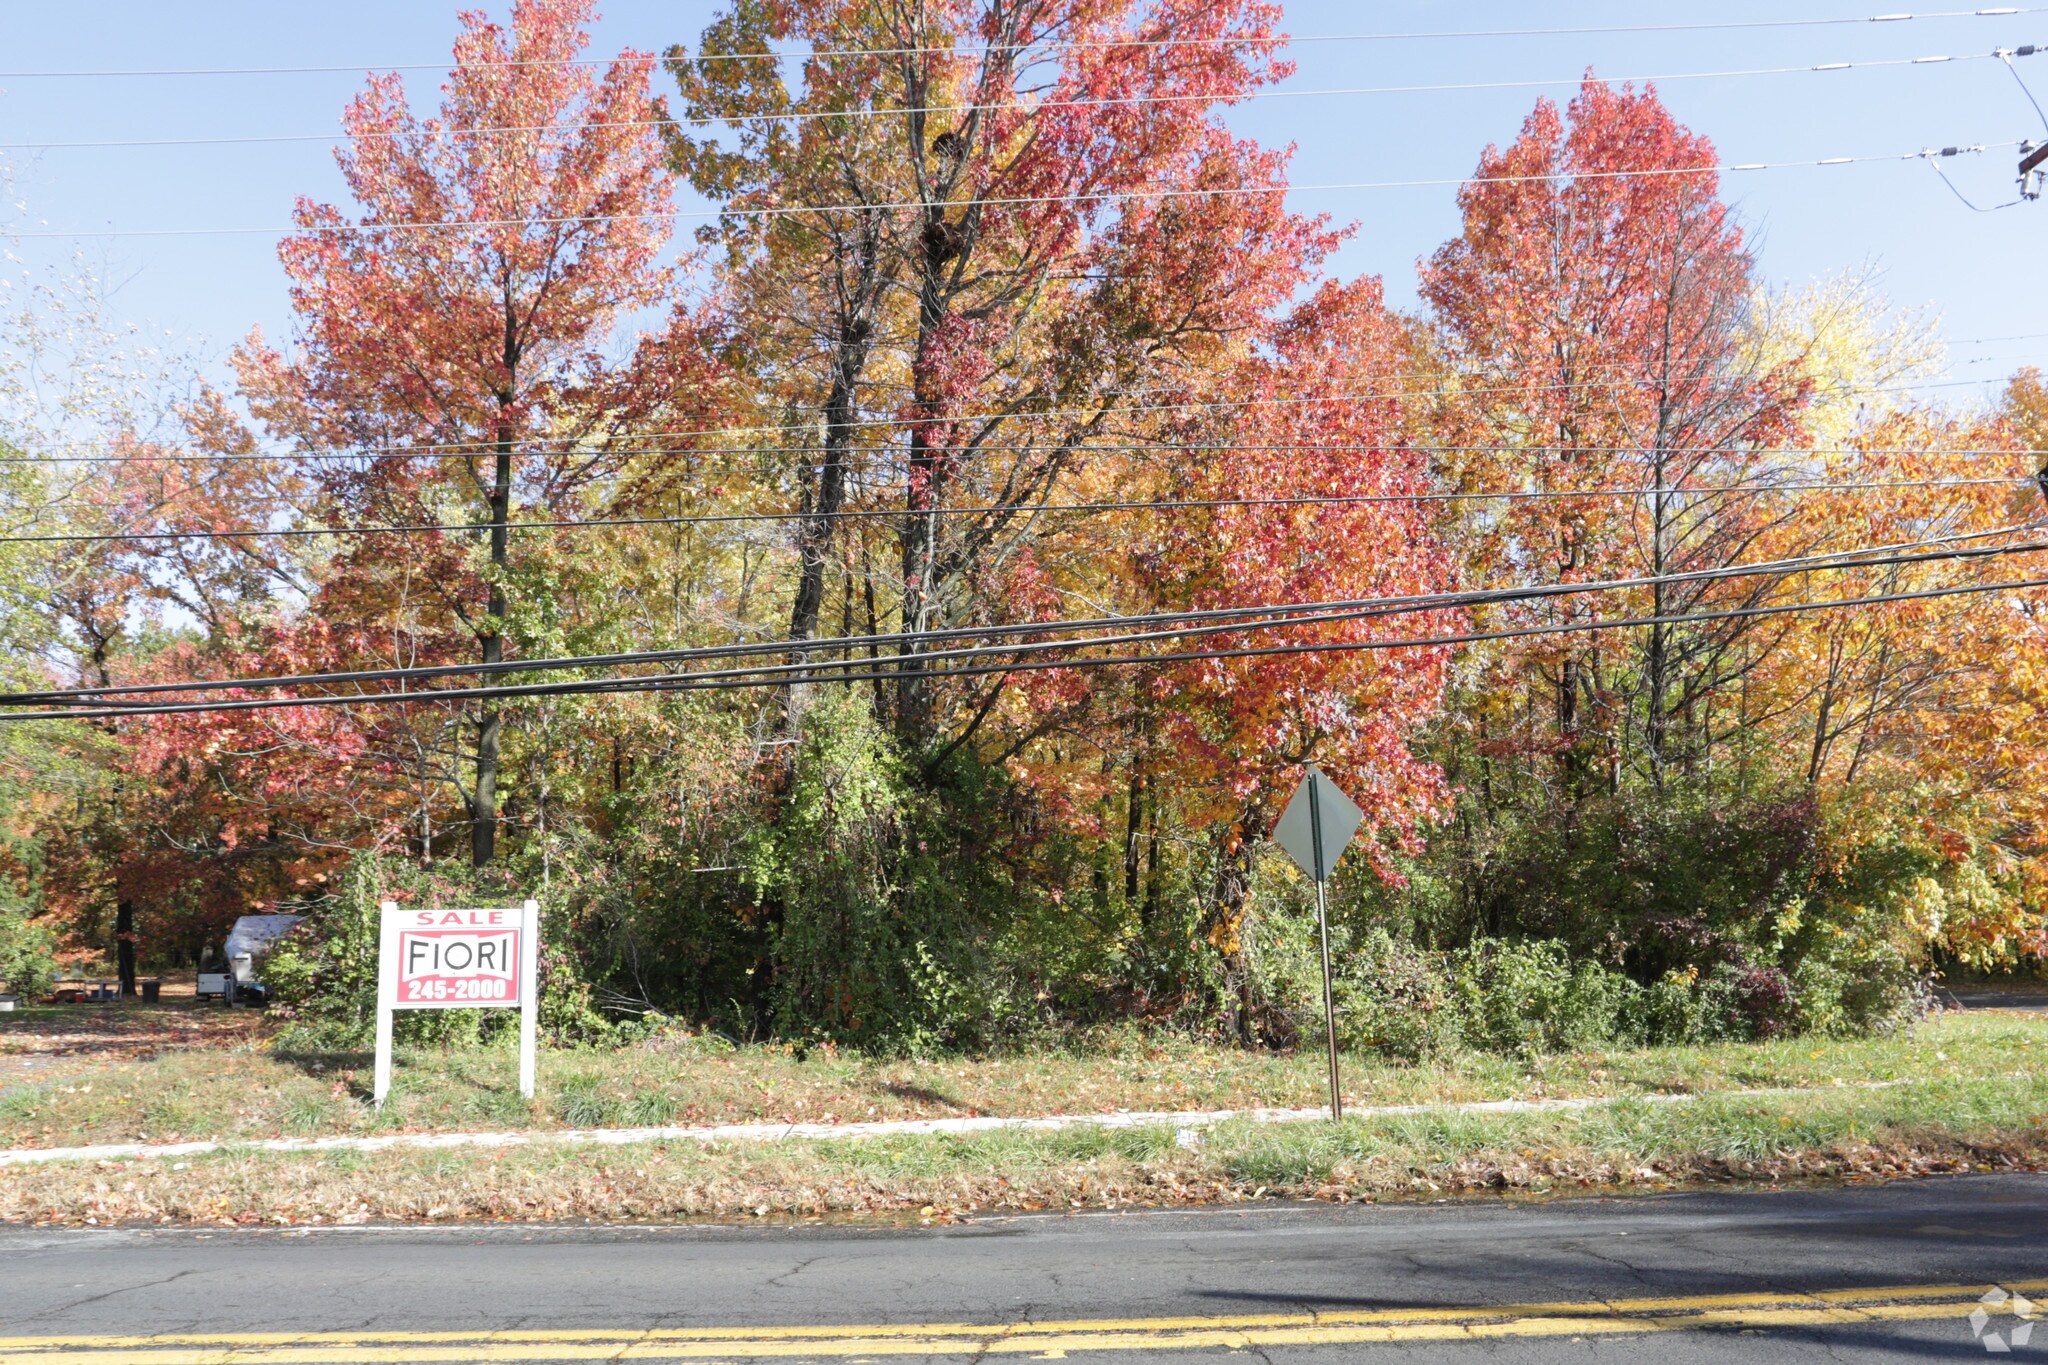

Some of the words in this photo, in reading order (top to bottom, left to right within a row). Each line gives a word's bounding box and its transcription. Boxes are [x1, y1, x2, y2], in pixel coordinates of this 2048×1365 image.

[417, 911, 503, 926] SALE
[408, 938, 508, 974] FIORI
[408, 979, 506, 1000] 245-2000
